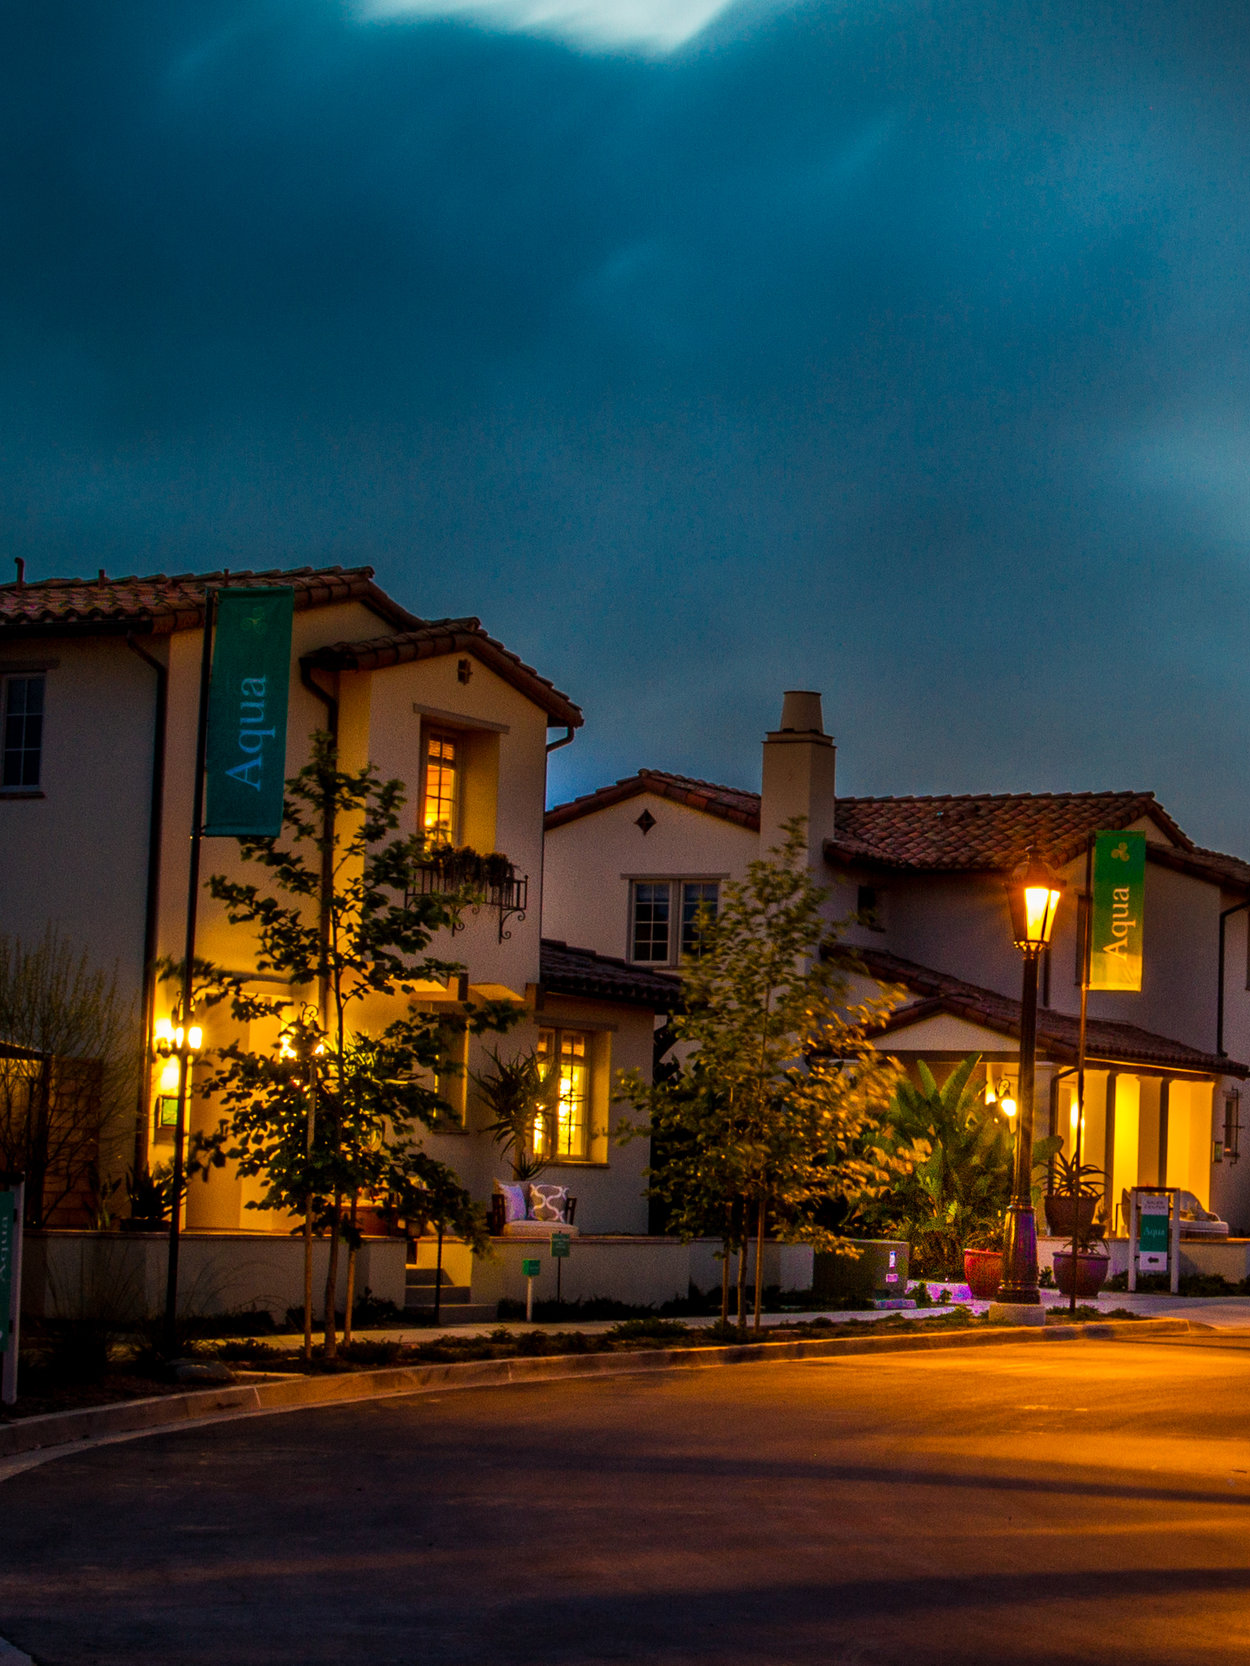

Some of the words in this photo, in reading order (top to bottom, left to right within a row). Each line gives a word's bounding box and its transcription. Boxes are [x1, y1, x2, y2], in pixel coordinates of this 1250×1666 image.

[224, 674, 276, 792] Aqua
[1102, 886, 1137, 961] Aqua
[1143, 1226, 1166, 1239] Aqua
